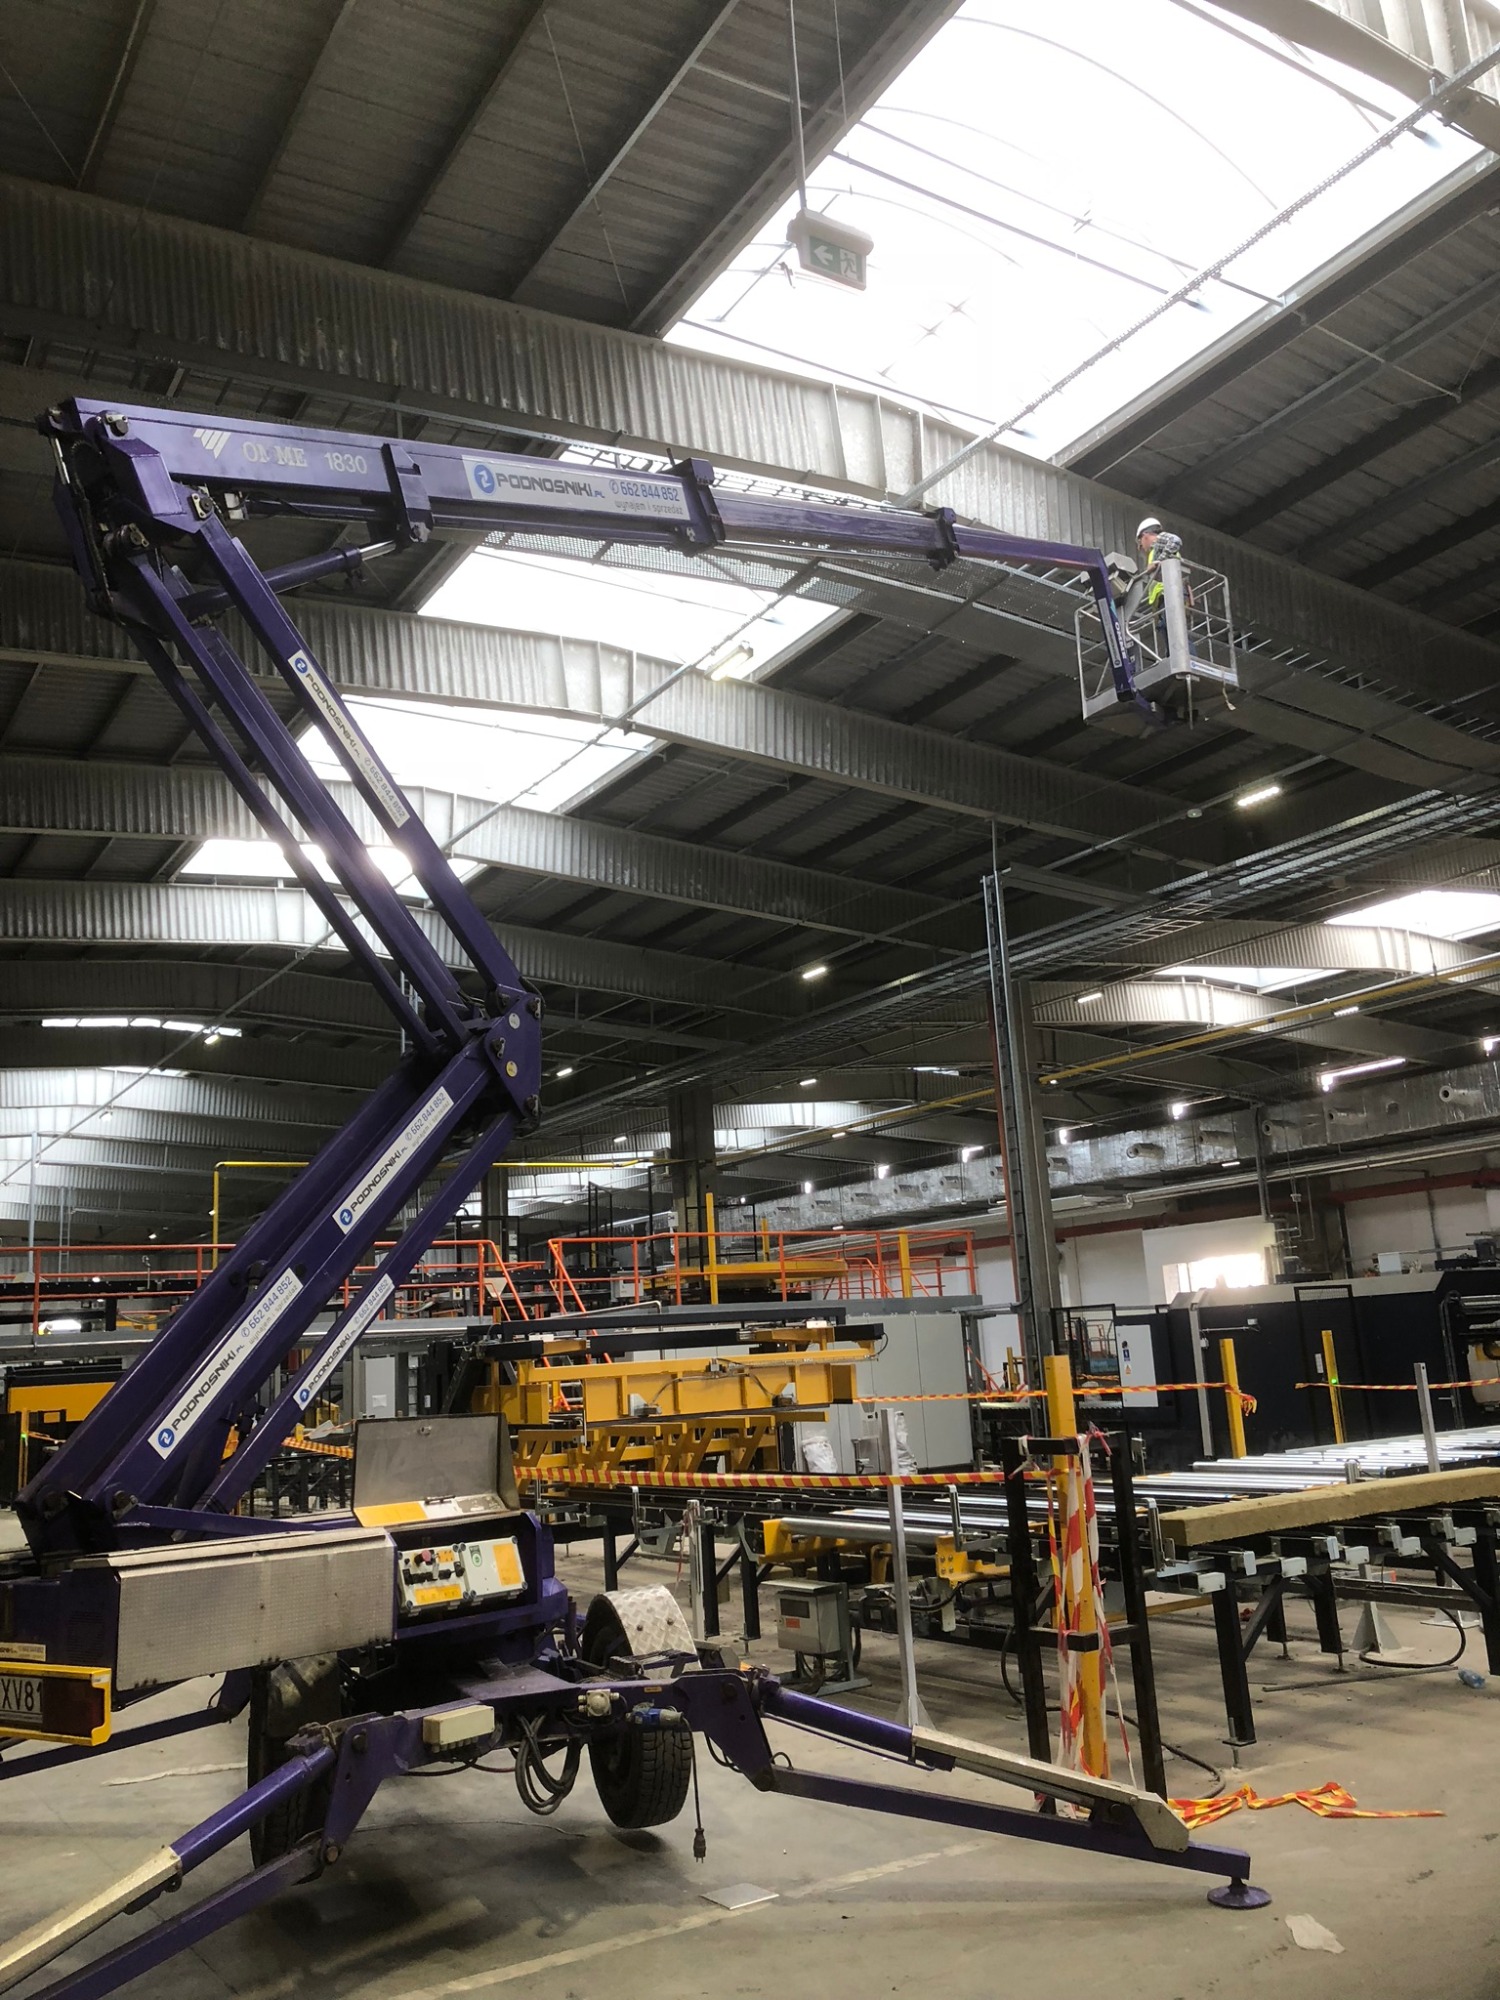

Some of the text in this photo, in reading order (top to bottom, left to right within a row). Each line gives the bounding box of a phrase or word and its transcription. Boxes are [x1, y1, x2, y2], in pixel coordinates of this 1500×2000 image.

[324, 452, 367, 474] 1830
[620, 481, 640, 497] 662
[641, 484, 660, 499] 844
[661, 486, 680, 502] 852
[370, 766, 383, 783] 662
[381, 783, 394, 801] 844
[410, 1118, 424, 1135] 662
[422, 1105, 435, 1121] 844
[433, 1092, 446, 1108] 852
[248, 1309, 265, 1329] 662
[262, 1292, 279, 1312] 844
[276, 1275, 293, 1295] 852
